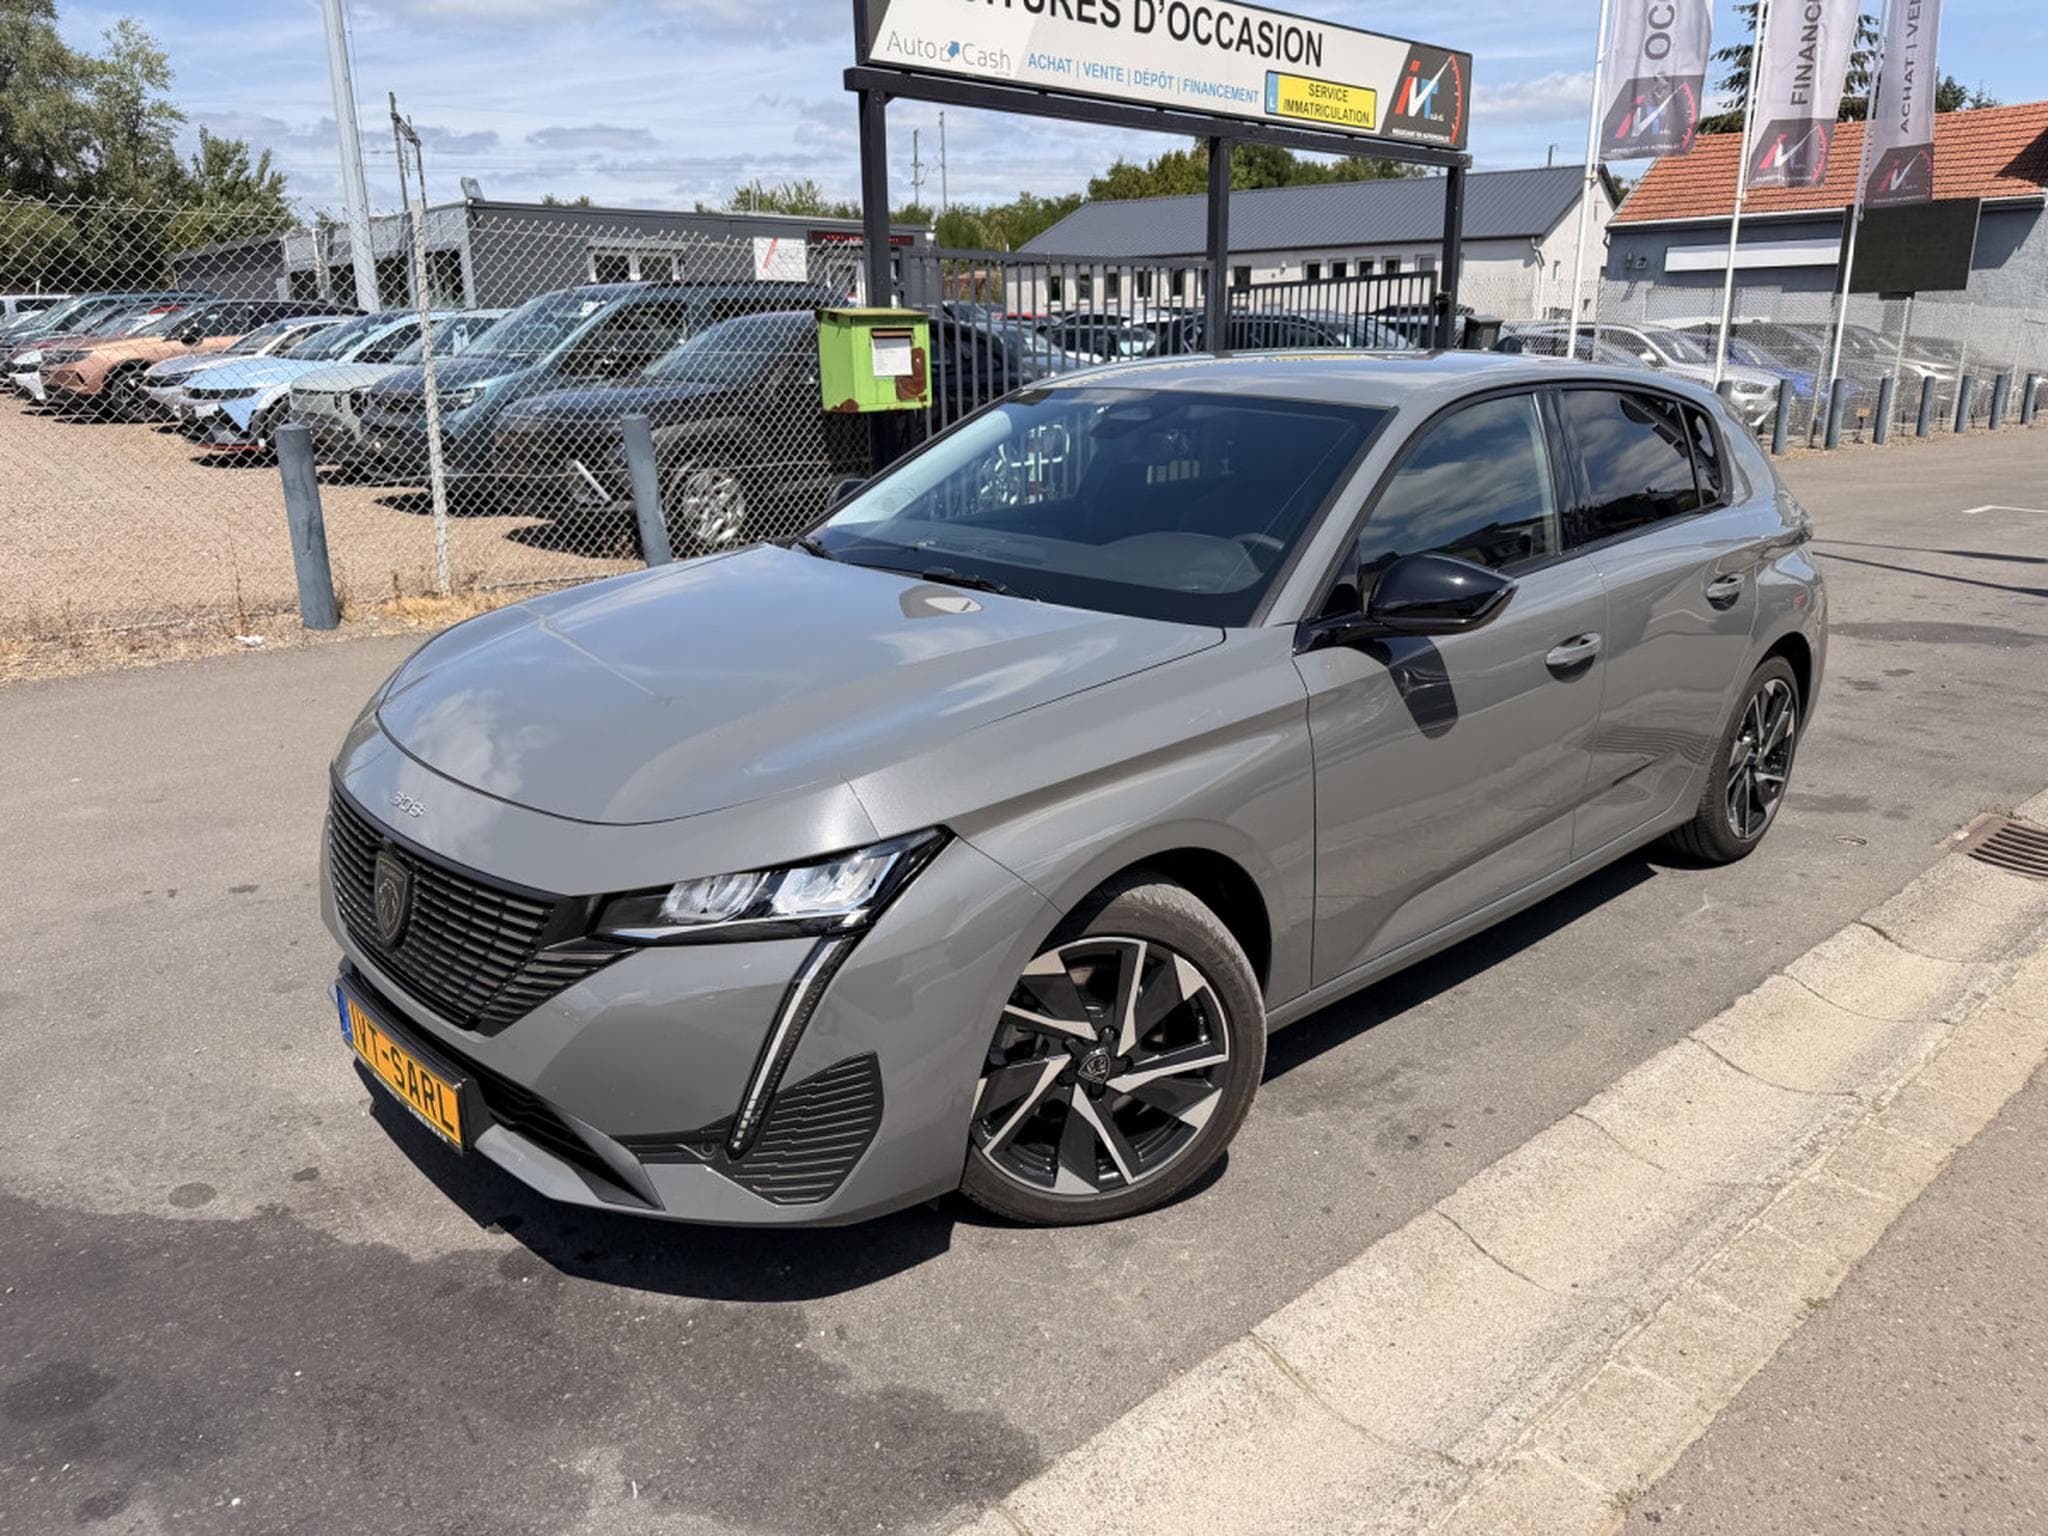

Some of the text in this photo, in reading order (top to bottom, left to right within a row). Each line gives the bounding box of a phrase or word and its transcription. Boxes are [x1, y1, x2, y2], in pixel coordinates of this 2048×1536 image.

[887, 30, 1011, 70] Auto Cash
[1645, 0, 1675, 60] OC
[1790, 0, 1822, 106] FINANC
[1028, 52, 1260, 104] ACHAT VENTE DÉPÔT FINANCEMENT
[1308, 82, 1349, 103] SERVICE
[1901, 60, 1915, 134] ACHAT
[1283, 98, 1370, 123] IMMATRICULATION
[390, 792, 426, 818] 308
